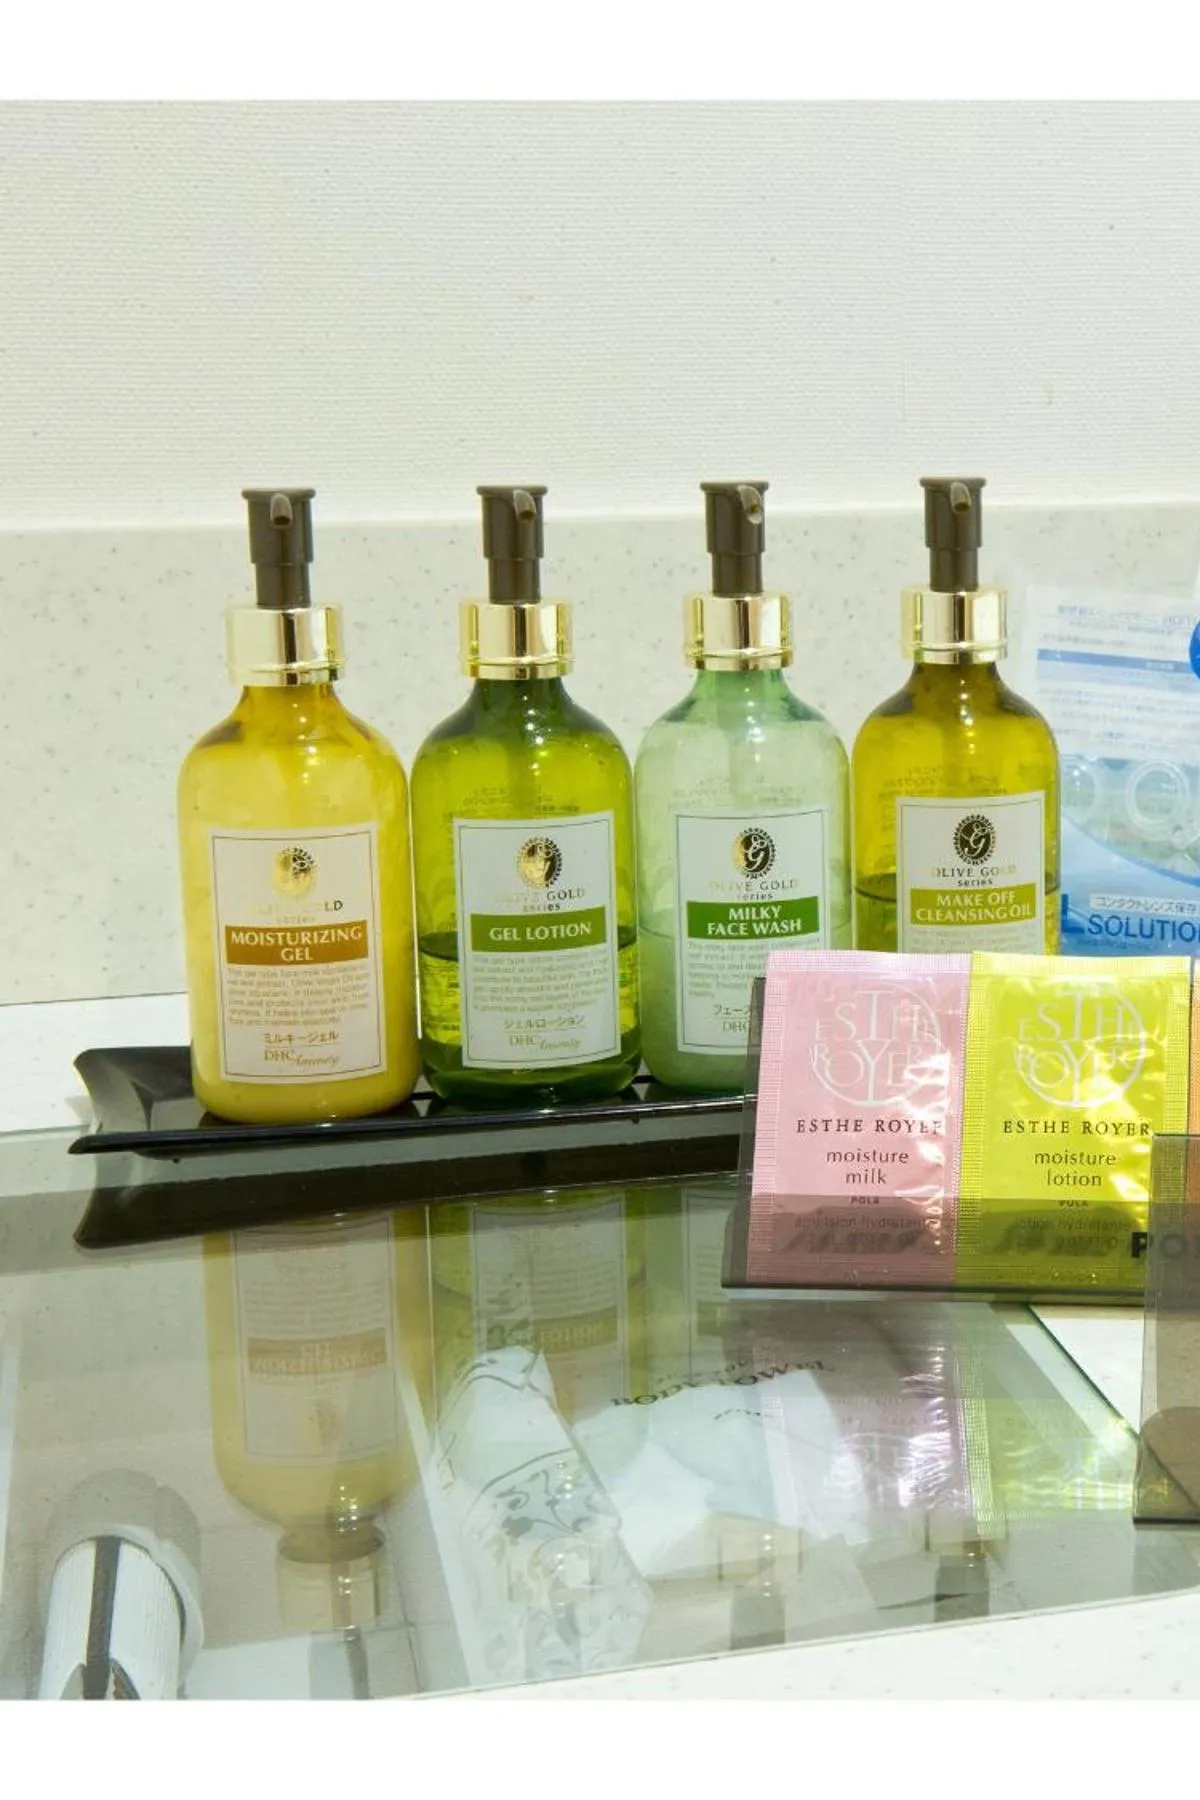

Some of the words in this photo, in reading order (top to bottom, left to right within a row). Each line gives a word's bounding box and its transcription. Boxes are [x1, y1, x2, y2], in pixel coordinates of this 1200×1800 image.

[937, 892, 983, 907] MAKE
[987, 890, 1017, 905] OFF
[728, 905, 781, 921] MILKY
[915, 906, 1009, 922] CLEANSING
[1011, 904, 1032, 920] OIL
[489, 927, 521, 941] GEL
[527, 922, 592, 940] LOTION
[707, 921, 750, 937] FACE
[752, 919, 801, 935] WASH
[231, 928, 362, 946] MOISTURIZING
[280, 947, 313, 962] GEL
[797, 1119, 863, 1133] ESTHE
[1003, 1120, 1070, 1134] ESTHE
[1082, 1121, 1151, 1136] ROYER
[826, 1149, 909, 1165] moisture
[1034, 1150, 1117, 1166] moisture
[845, 1169, 887, 1186] milk
[1047, 1170, 1102, 1187] lotion
[850, 1196, 880, 1206] POLA
